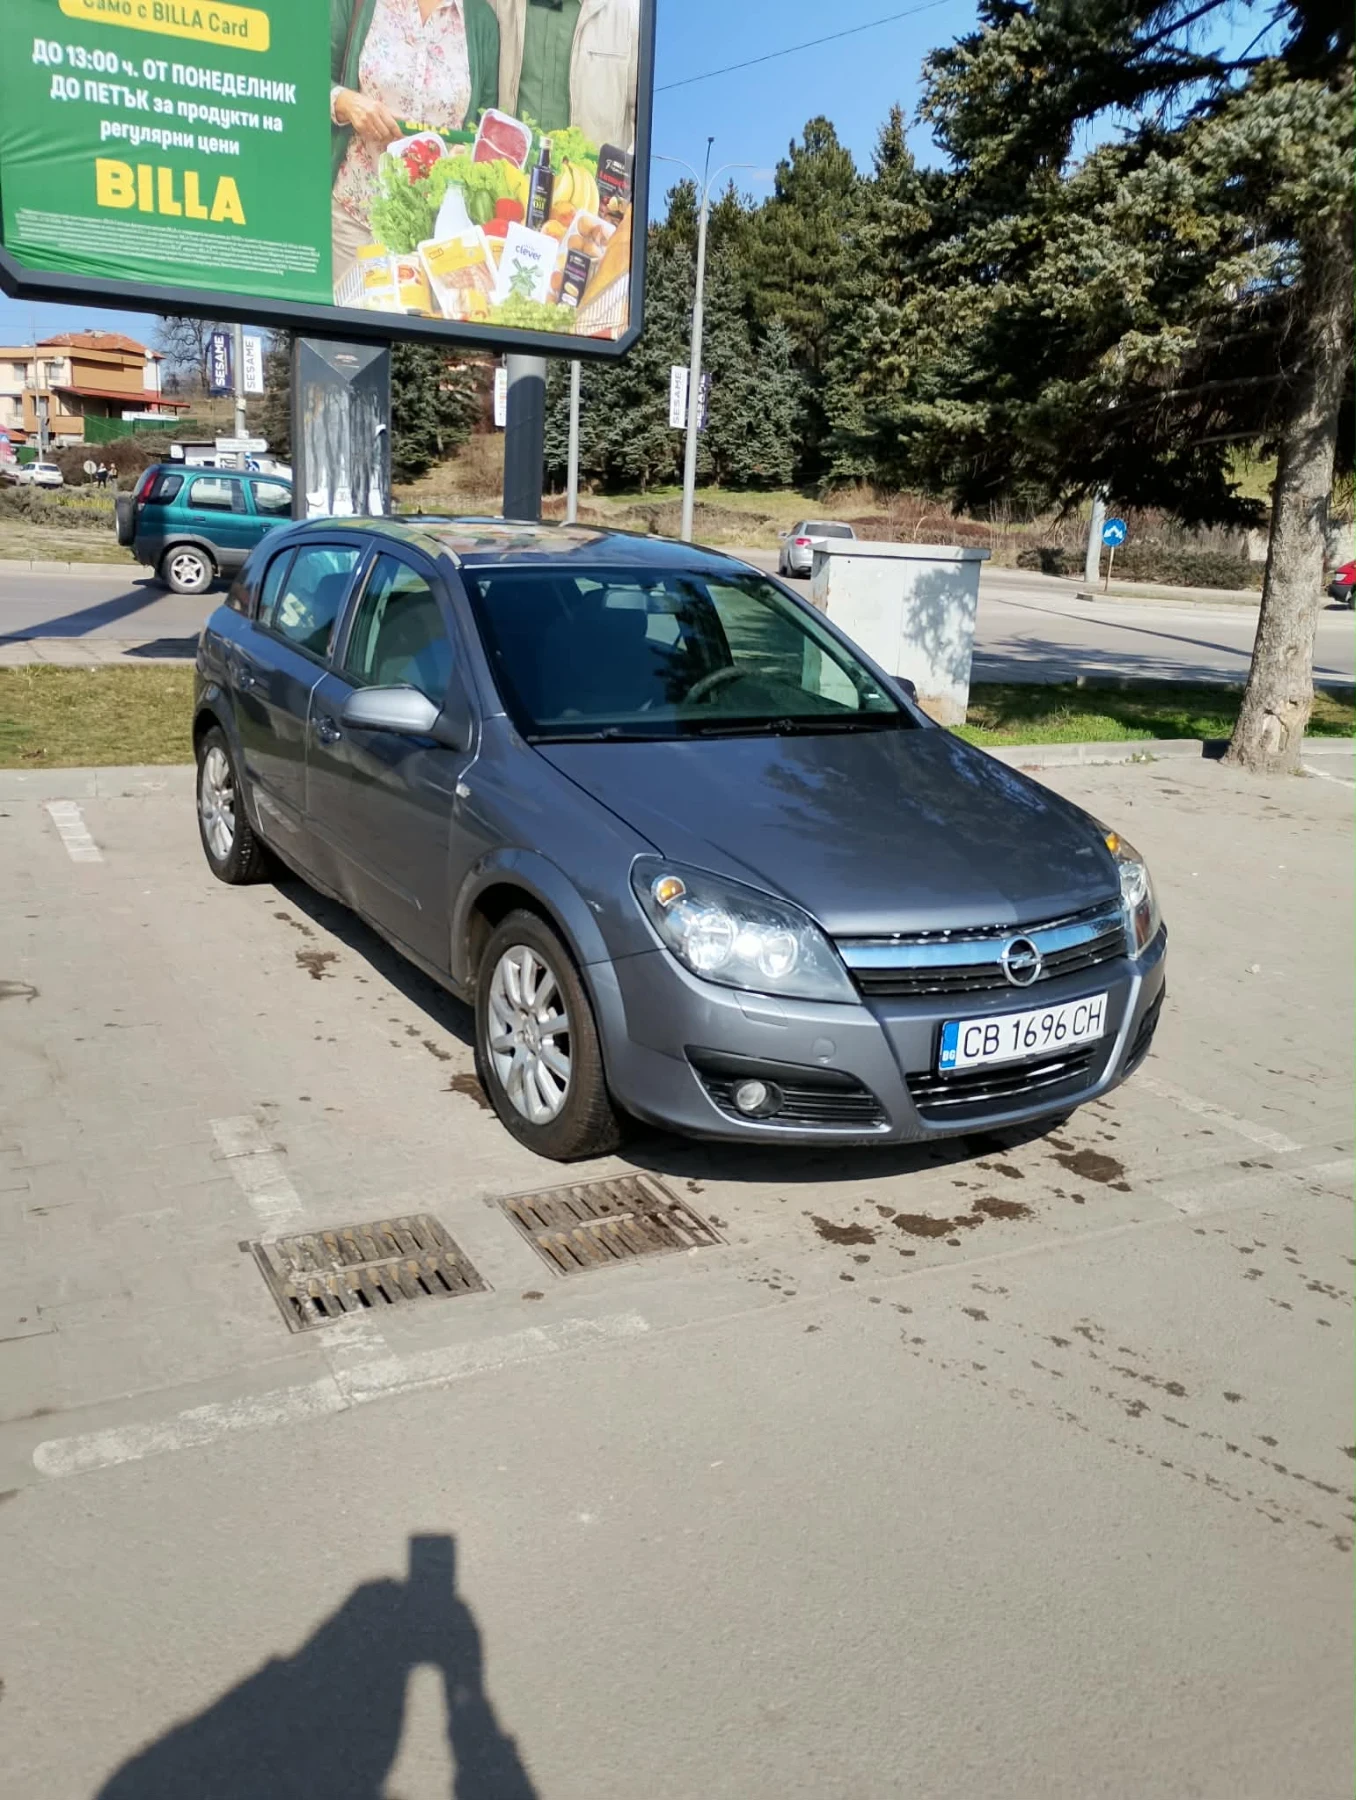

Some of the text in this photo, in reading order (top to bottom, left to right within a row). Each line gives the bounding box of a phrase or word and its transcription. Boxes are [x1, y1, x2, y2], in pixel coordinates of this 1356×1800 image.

[154, 4, 204, 29] BILLA
[208, 13, 249, 38] Card
[32, 38, 297, 105] ДО 13:00 ч. ОТ ПОНЕДЕЛНИК
[50, 74, 283, 132] ДО ПЕТЪК за продукти на
[100, 119, 240, 156] регулярни цени
[95, 157, 247, 226] BILLA
[515, 244, 542, 261] clever
[214, 335, 226, 387] SESAME
[245, 339, 256, 389] SESAME
[673, 371, 682, 425] SESAME
[964, 1000, 1102, 1058] CB 1696 CH
[942, 1050, 956, 1062] BG
